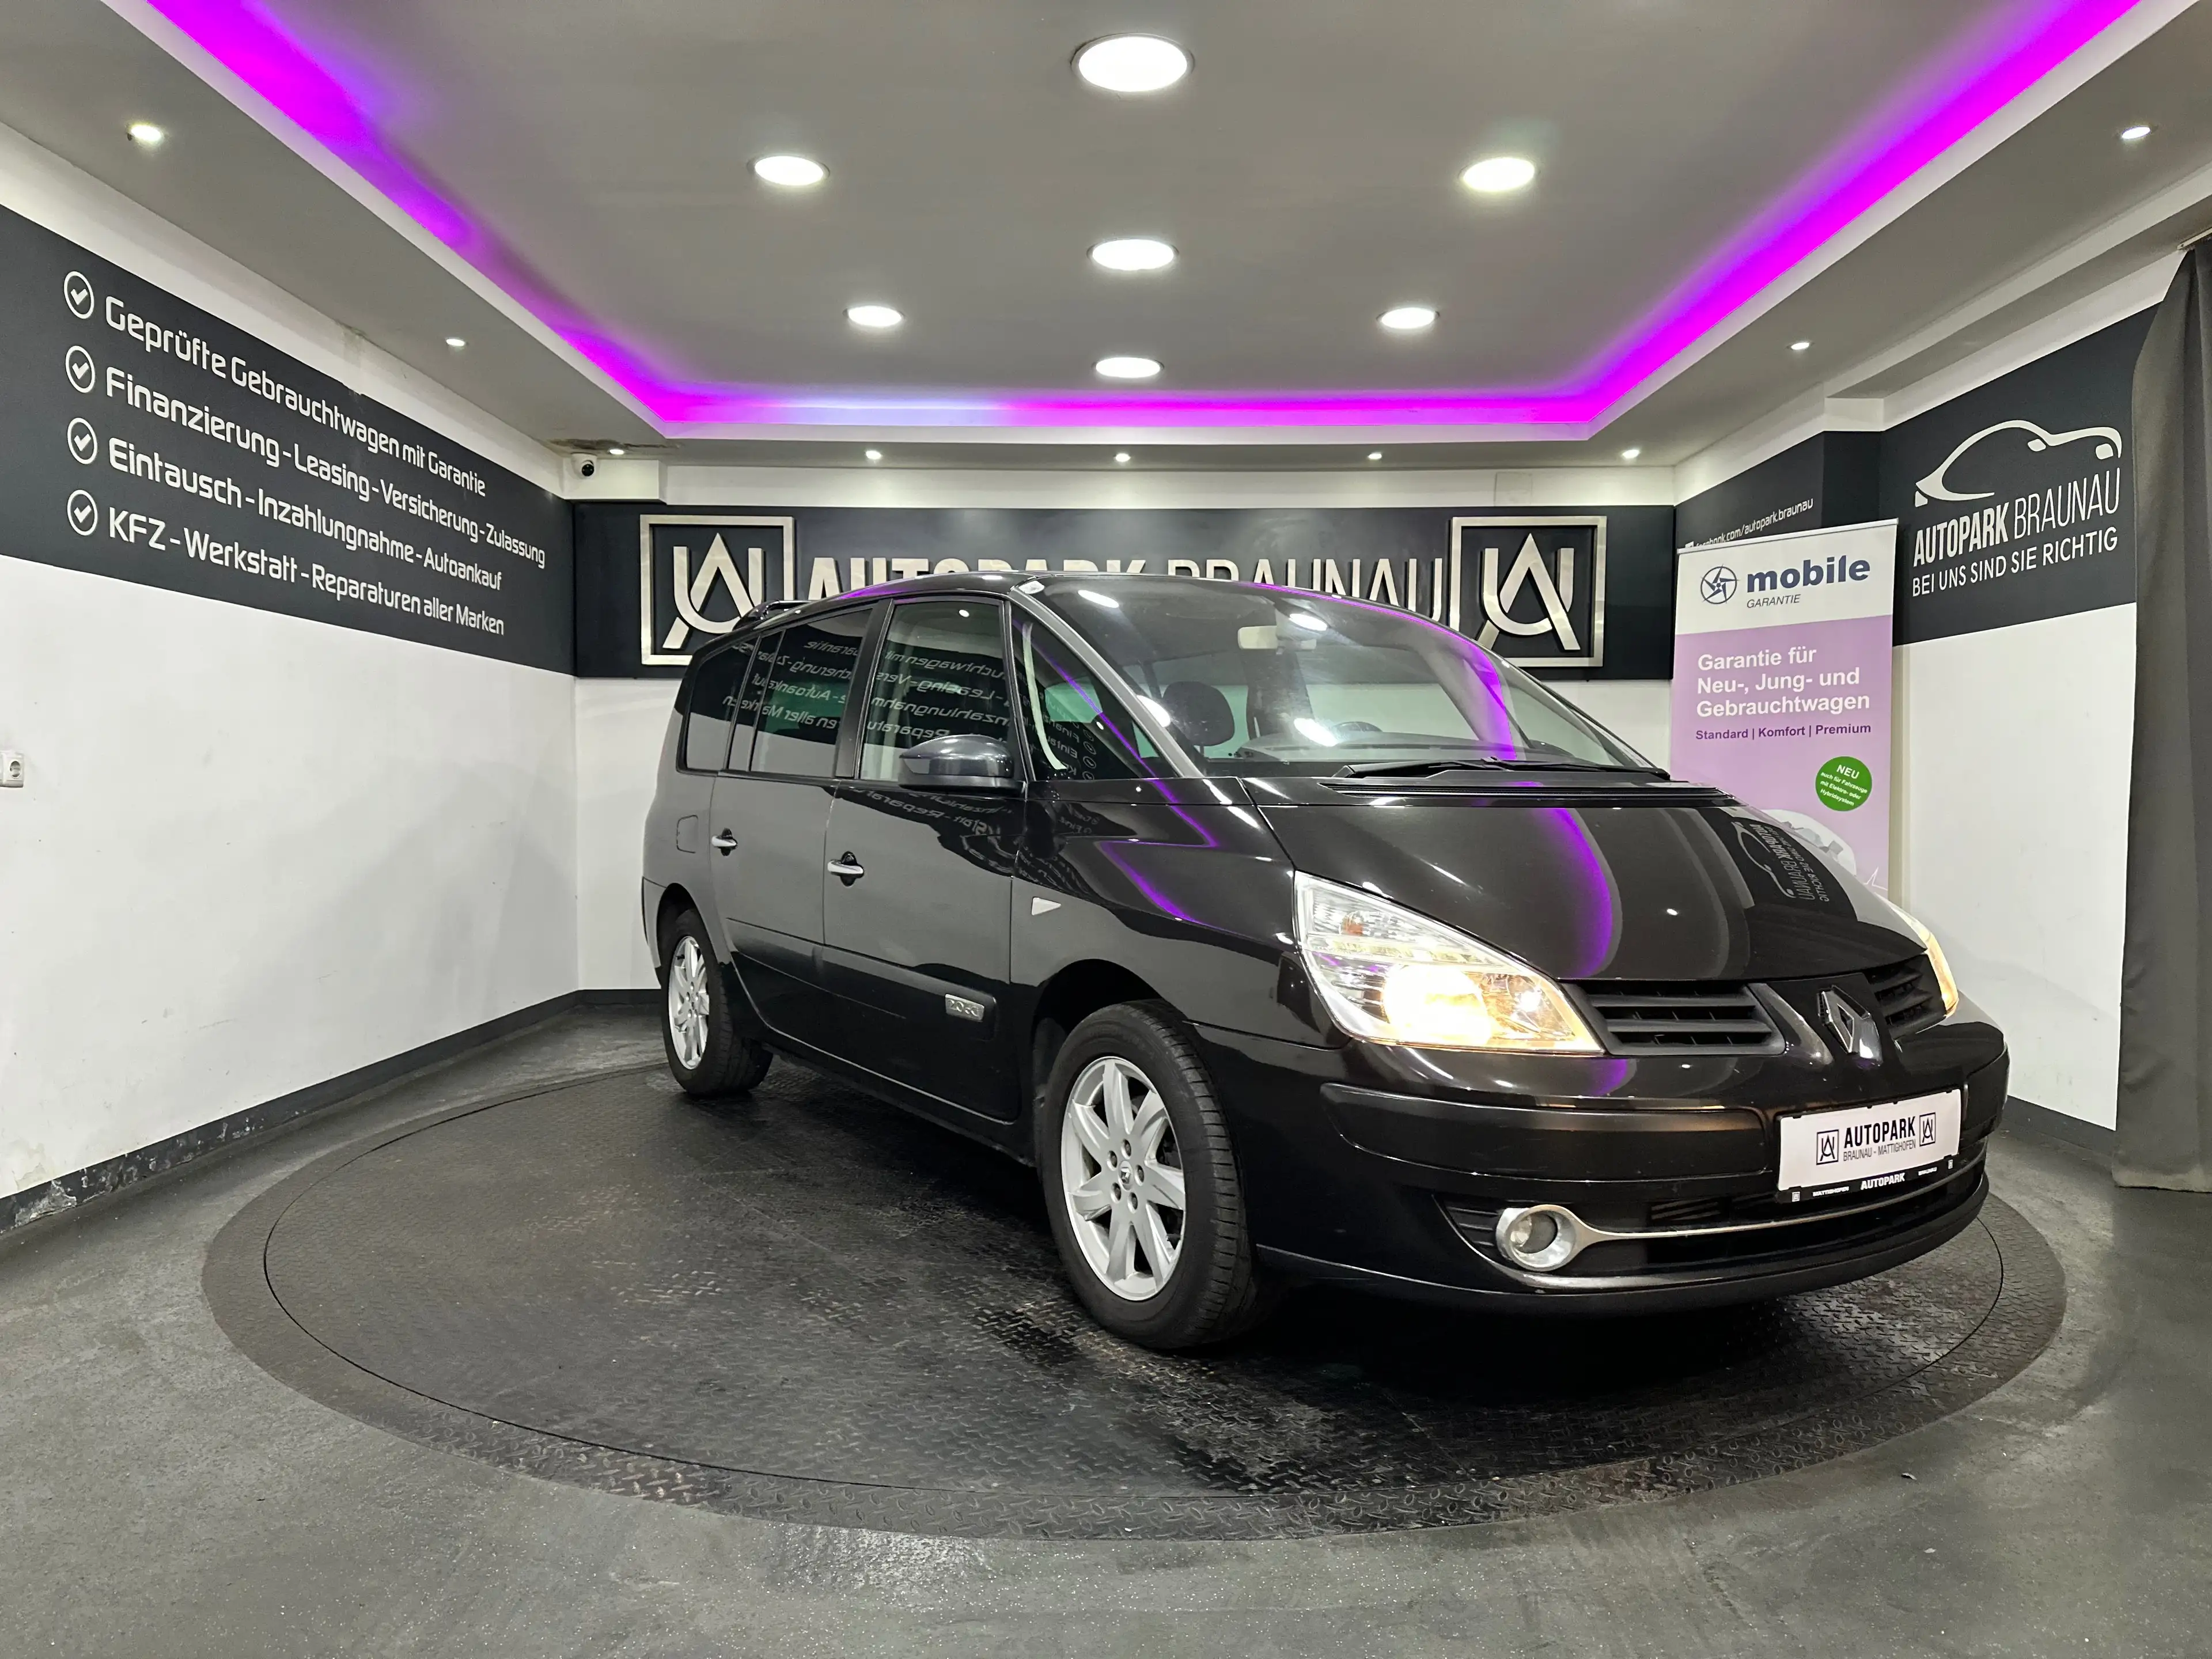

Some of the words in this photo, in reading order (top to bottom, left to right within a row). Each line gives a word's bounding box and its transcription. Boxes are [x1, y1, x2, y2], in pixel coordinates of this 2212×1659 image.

[106, 296, 226, 379] Geprüfte
[232, 357, 399, 458] Gebrauchtwagen
[403, 444, 426, 469] mit
[428, 452, 486, 497] Garantie
[106, 366, 279, 468] Finanzierung
[294, 442, 370, 502] Leasing
[380, 479, 478, 543] Versicherung
[486, 522, 546, 569] Zulassung
[109, 437, 241, 509] Eintausch
[259, 488, 414, 563] Inzahlungnahme
[423, 547, 502, 590] Autoankauf
[1913, 502, 2009, 567] AUTOPARK
[2014, 467, 2120, 539] BRAUNAU
[109, 507, 166, 551] KFZ
[183, 527, 298, 583] Werkstatt
[312, 563, 421, 615] Reparaturen
[423, 597, 453, 624] aller
[456, 604, 505, 635] Marken
[1747, 555, 1870, 593] mobile
[1912, 573, 1934, 597] BEI
[1939, 565, 1966, 591] UNS
[1970, 555, 2007, 583] SIND
[2011, 546, 2037, 574] SIE
[2043, 527, 2118, 566] RICHTIG
[1747, 594, 1801, 609] GARANTIE
[1698, 649, 1782, 671] Garantie
[1788, 646, 1817, 664] für
[1697, 677, 1749, 695] Neu-,
[1755, 673, 1813, 692] Jung-
[1819, 667, 1860, 686] und
[1696, 695, 1870, 717] Gebrauchtwagen
[1696, 728, 1748, 740] Standard
[1758, 725, 1805, 738] Komfort
[1816, 723, 1872, 735] Premium
[1836, 764, 1860, 779] NEU
[1844, 1116, 1916, 1149] AUTOPARK
[1843, 1146, 1873, 1161] BRAUNAU
[1877, 1138, 1916, 1156] MATTIGHOFEN
[1861, 1172, 1906, 1191] AUTOPARK
